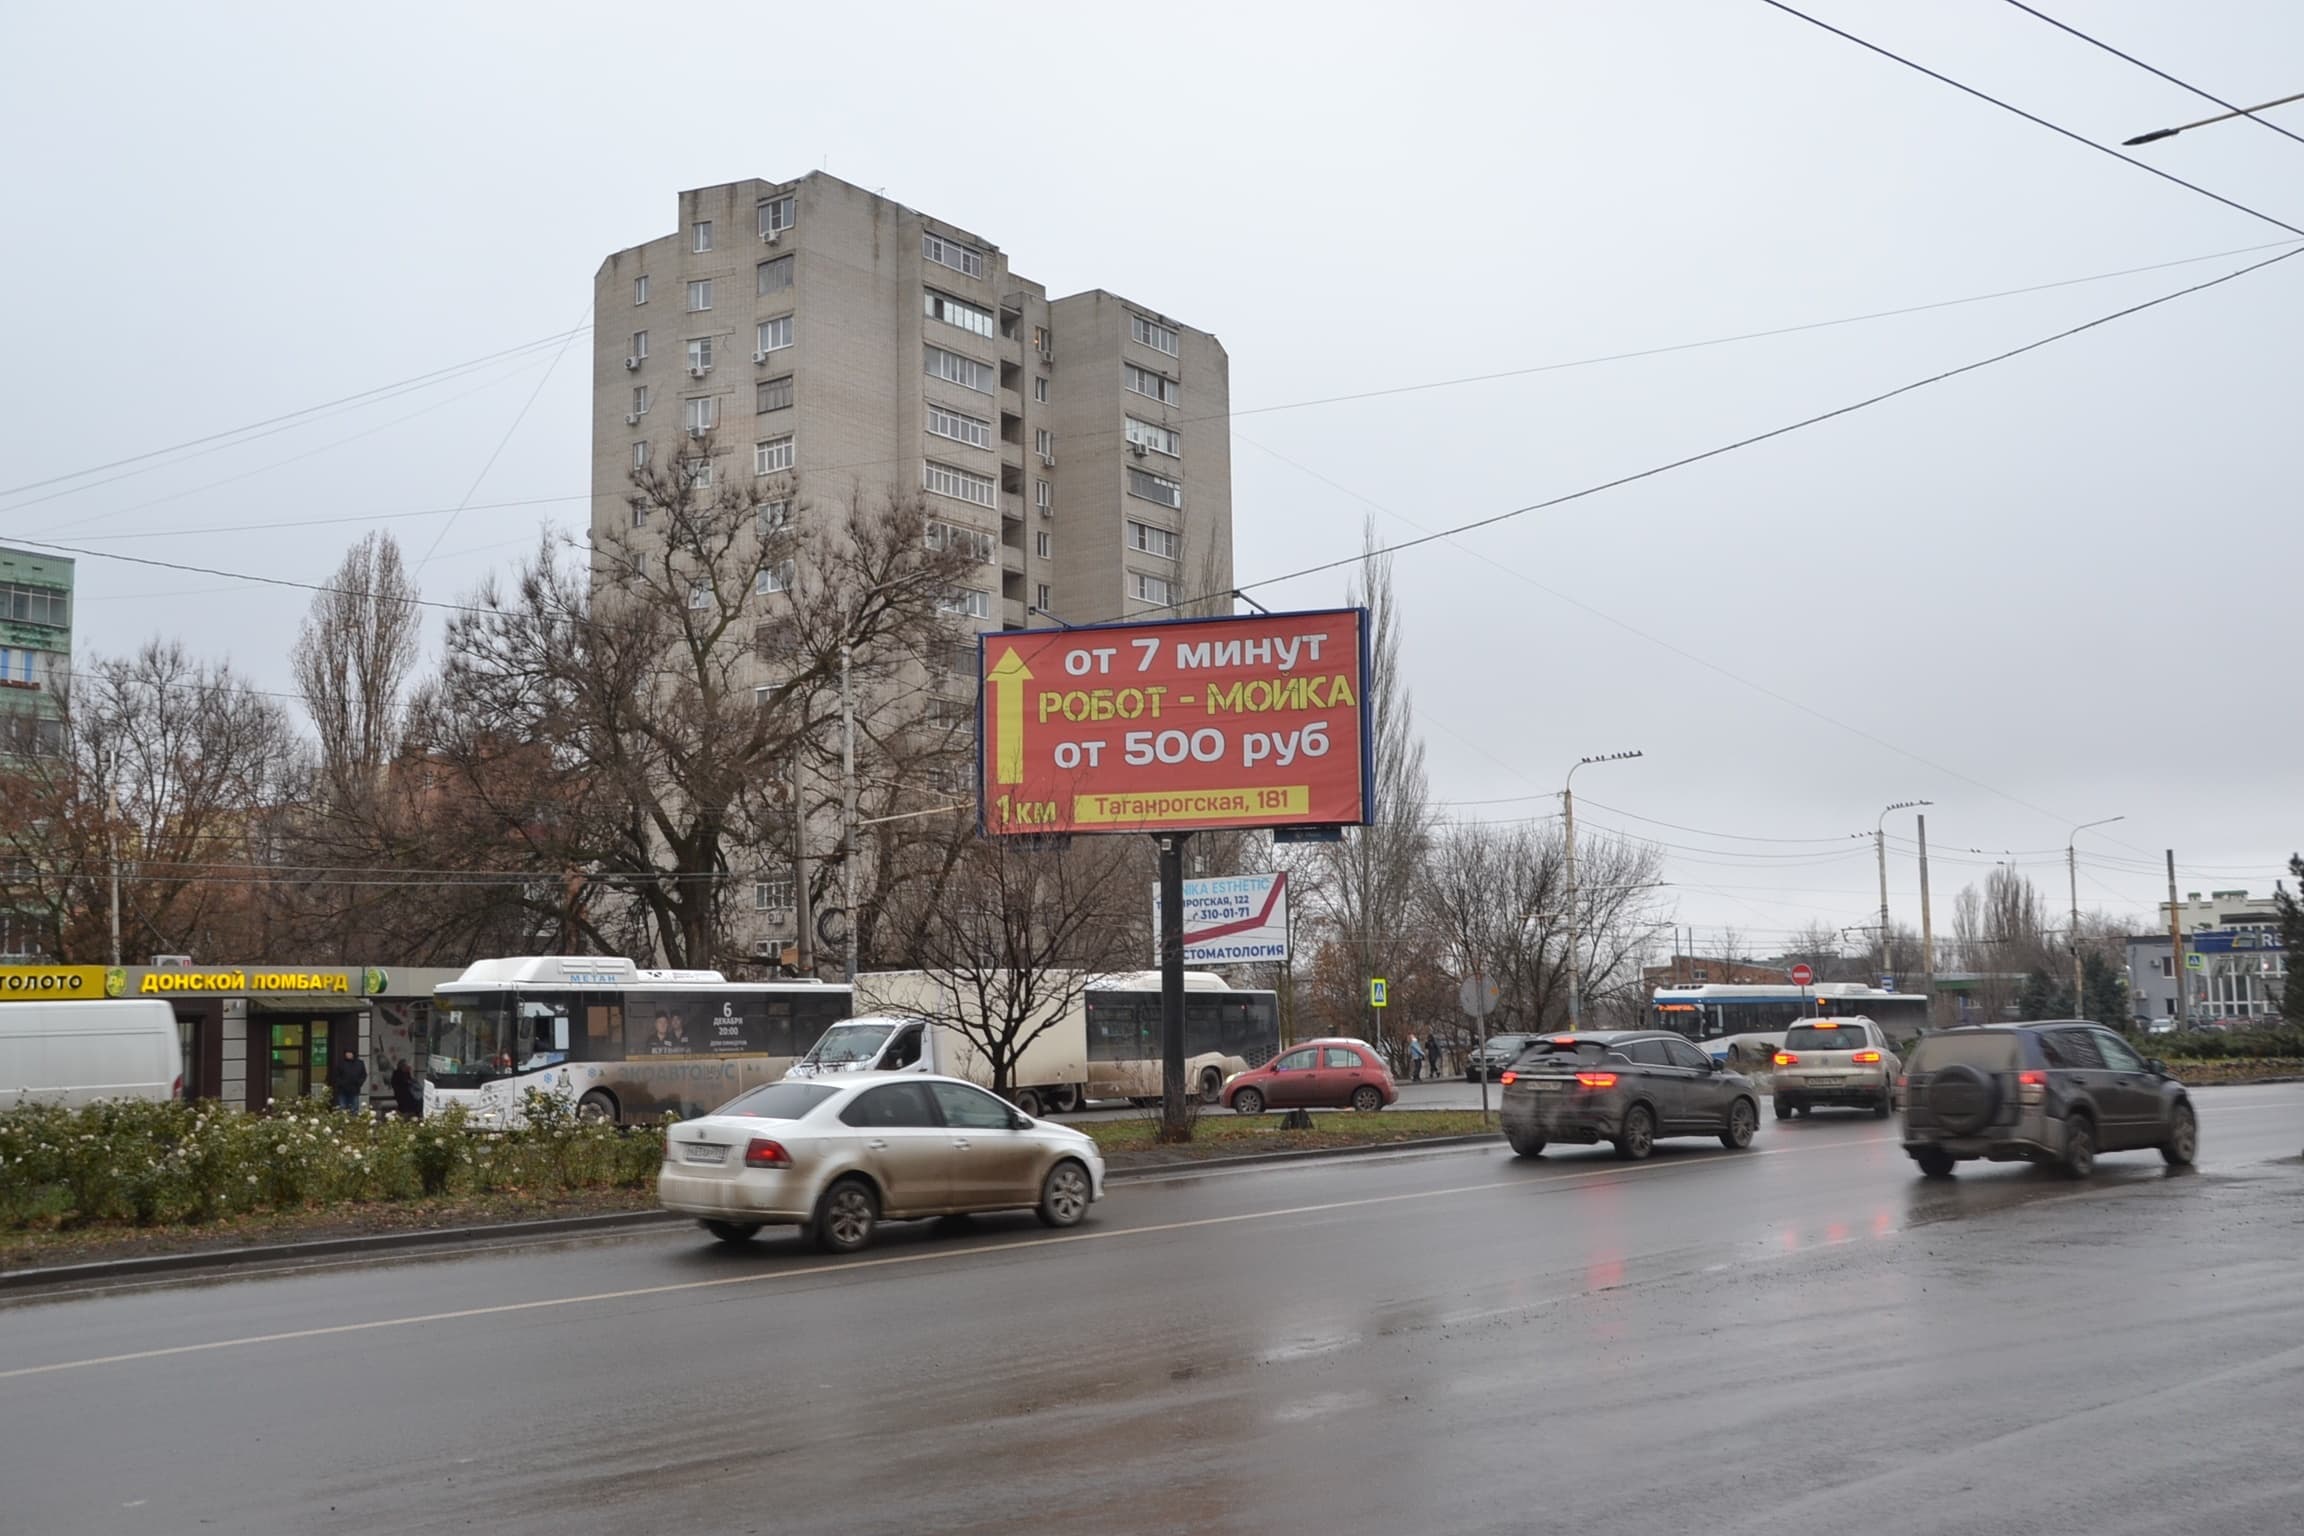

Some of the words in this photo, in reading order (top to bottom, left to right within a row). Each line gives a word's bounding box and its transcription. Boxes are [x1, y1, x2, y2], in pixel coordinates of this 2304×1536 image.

[1064, 648, 1117, 676] от
[1131, 637, 1160, 672] 7
[1176, 633, 1328, 672] минут
[1038, 686, 1168, 724] РОБОТ
[1179, 695, 1195, 704] -
[1207, 671, 1356, 715] МОЙКА
[1054, 741, 1106, 768] от
[1124, 728, 1225, 765] 500
[1242, 721, 1330, 768] руб
[997, 795, 1010, 824] 1
[1094, 795, 1250, 817] Таганрогская,
[1257, 789, 1288, 809] 181
[1212, 877, 1271, 893] ESTHETIC
[1234, 895, 1249, 904] 122
[1184, 944, 1284, 960] СТОМАТОЛОГИЯ
[140, 970, 245, 993] ДОНСКОЙ
[251, 974, 348, 992] ЛОМБАРД
[570, 975, 616, 983] МЕТАН
[723, 1002, 732, 1017] 6
[713, 1017, 743, 1026] ДЕКАБРЯ
[718, 1026, 739, 1036] 20:00
